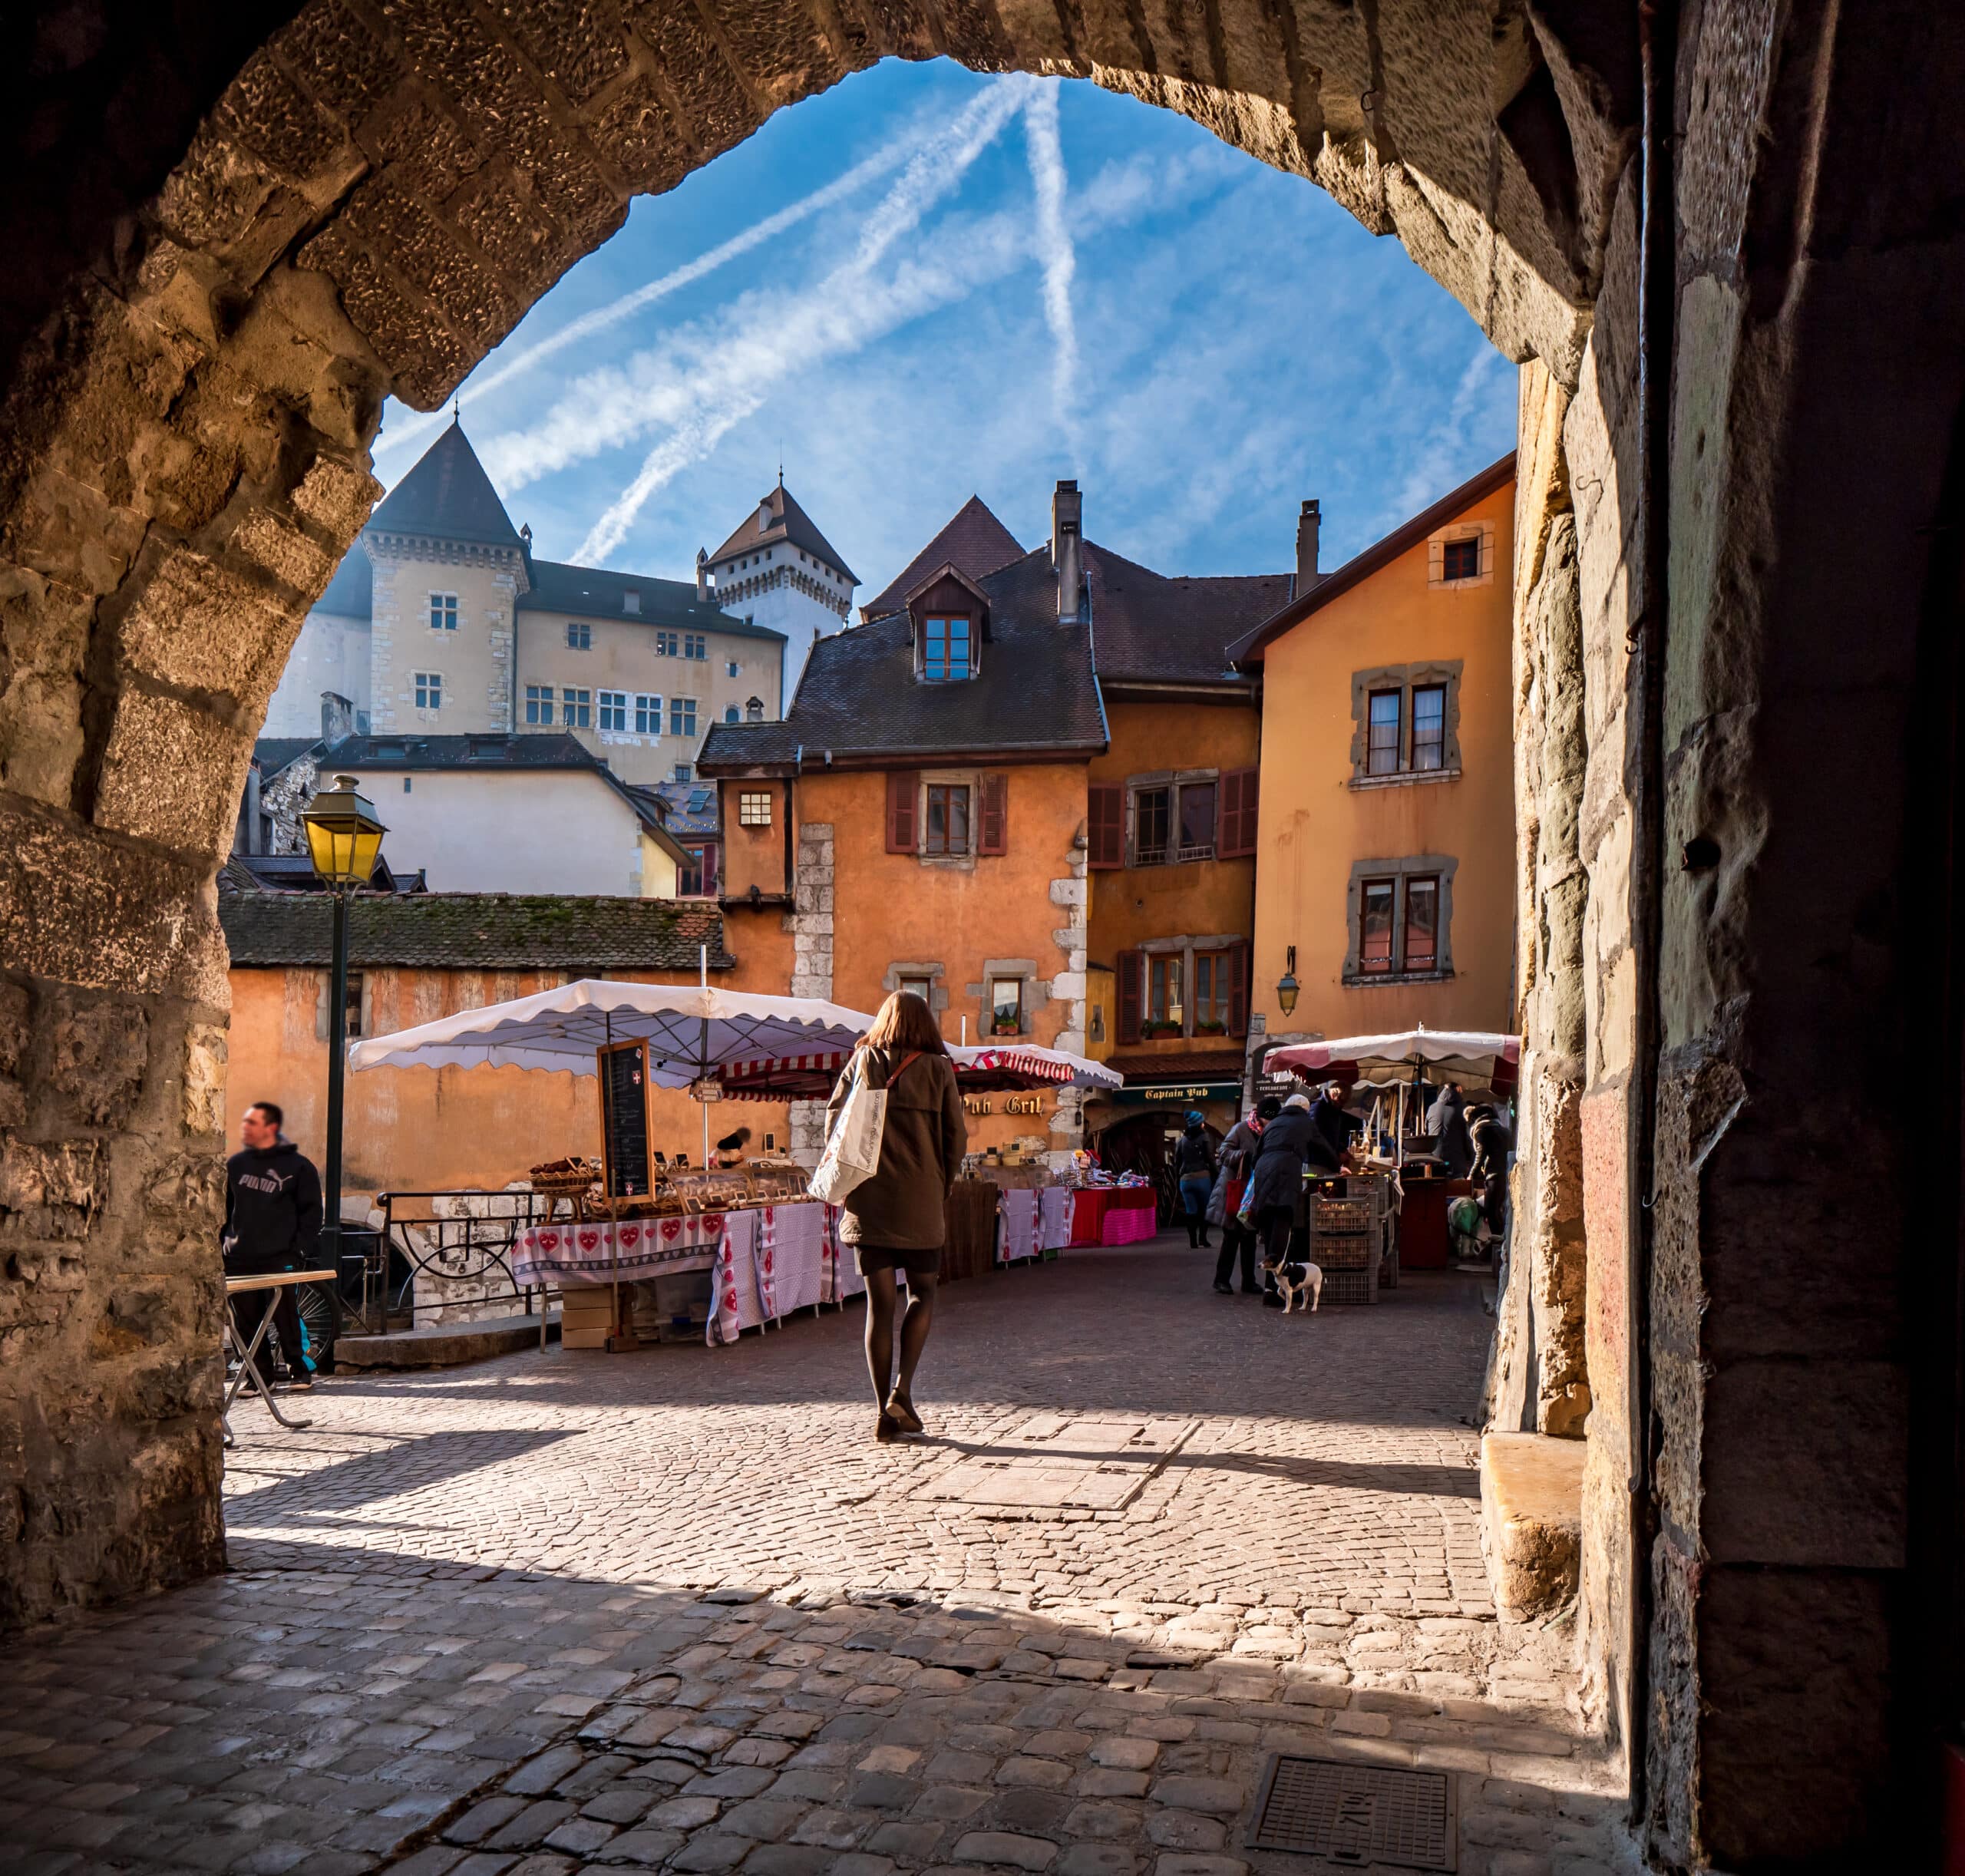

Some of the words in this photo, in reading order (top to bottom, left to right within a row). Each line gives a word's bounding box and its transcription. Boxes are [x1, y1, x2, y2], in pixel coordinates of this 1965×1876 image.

[1144, 1089, 1184, 1101] Captain
[1187, 1087, 1208, 1098] Pub
[239, 1174, 277, 1193] PUMA
